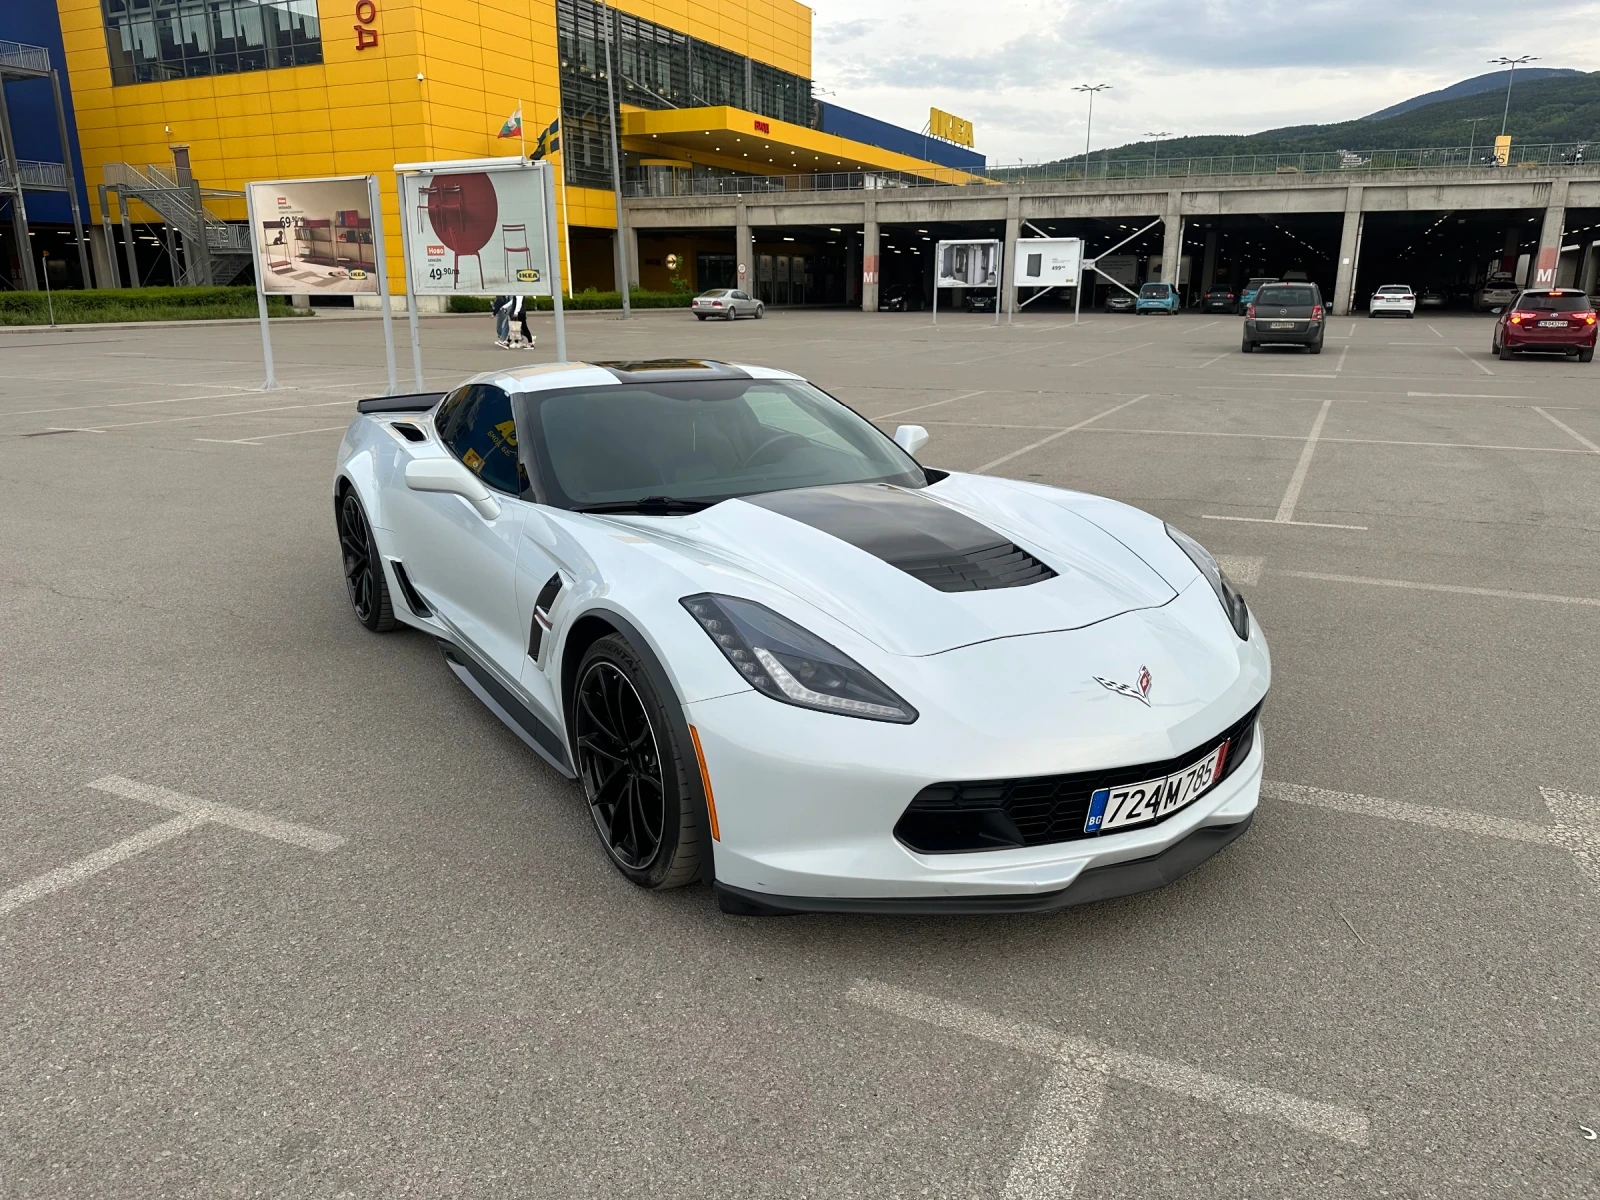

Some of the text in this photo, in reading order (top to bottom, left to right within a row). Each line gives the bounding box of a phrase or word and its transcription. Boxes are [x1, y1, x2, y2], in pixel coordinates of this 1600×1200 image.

[930, 107, 974, 148] IKEA
[863, 271, 873, 283] M
[1536, 268, 1553, 282] M
[1107, 784, 1163, 824] 724
[1163, 776, 1183, 810] M
[1182, 755, 1216, 802] 785
[1088, 815, 1102, 826] BG
